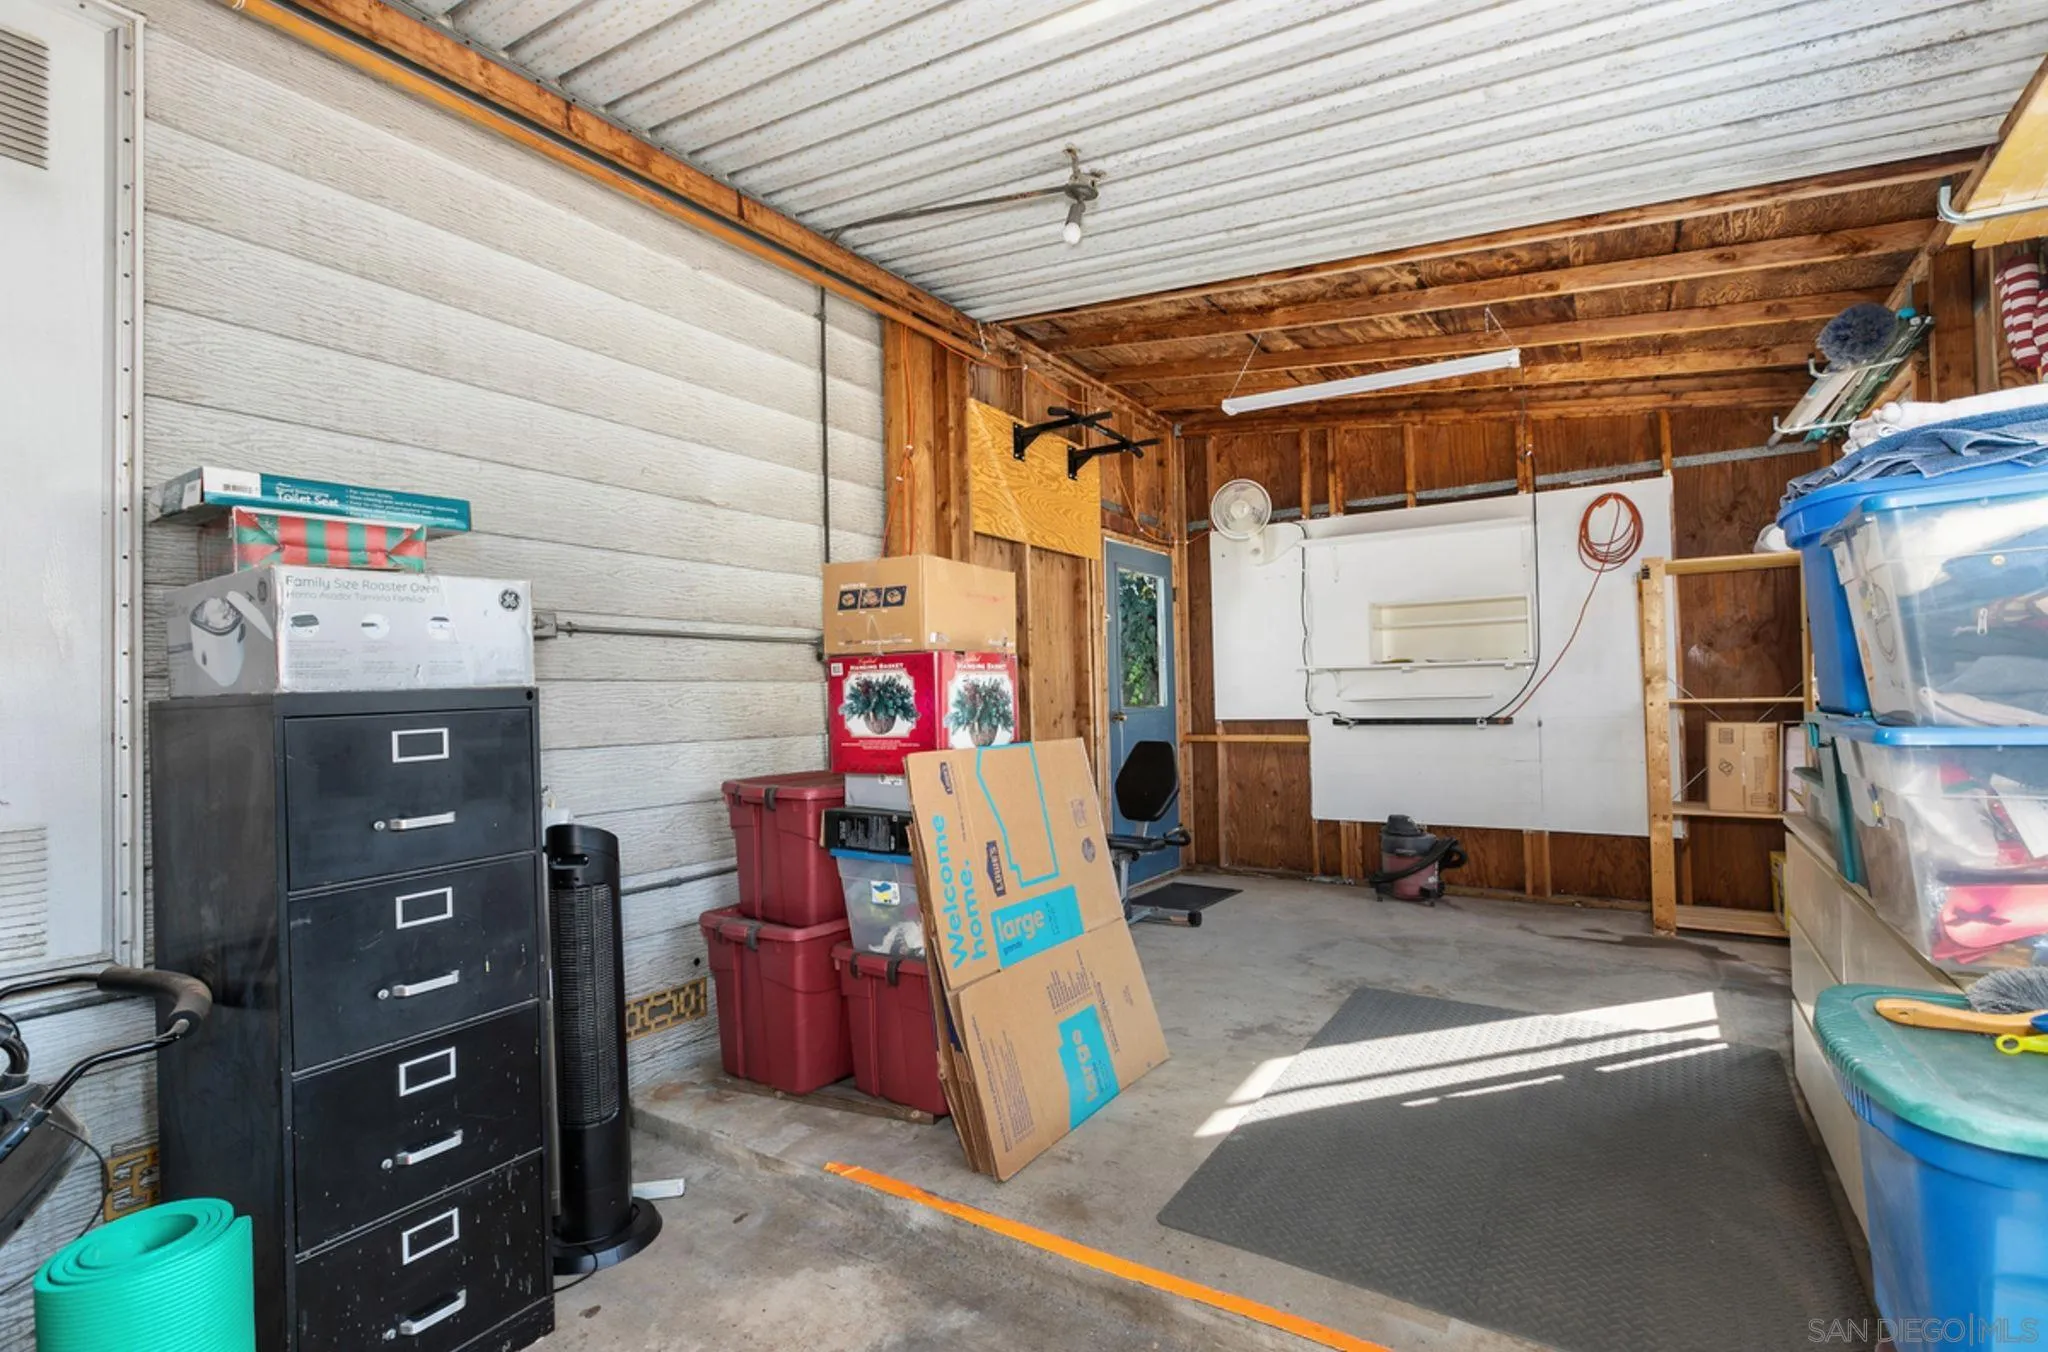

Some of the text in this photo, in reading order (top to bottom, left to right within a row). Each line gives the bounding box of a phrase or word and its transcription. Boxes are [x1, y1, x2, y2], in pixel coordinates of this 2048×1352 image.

[277, 491, 311, 504] Toilet
[314, 494, 339, 507] Seat
[285, 575, 440, 594] Family Size Roaster Oven
[932, 814, 968, 969] Welcome
[960, 859, 988, 960] home.
[996, 910, 1045, 943] large
